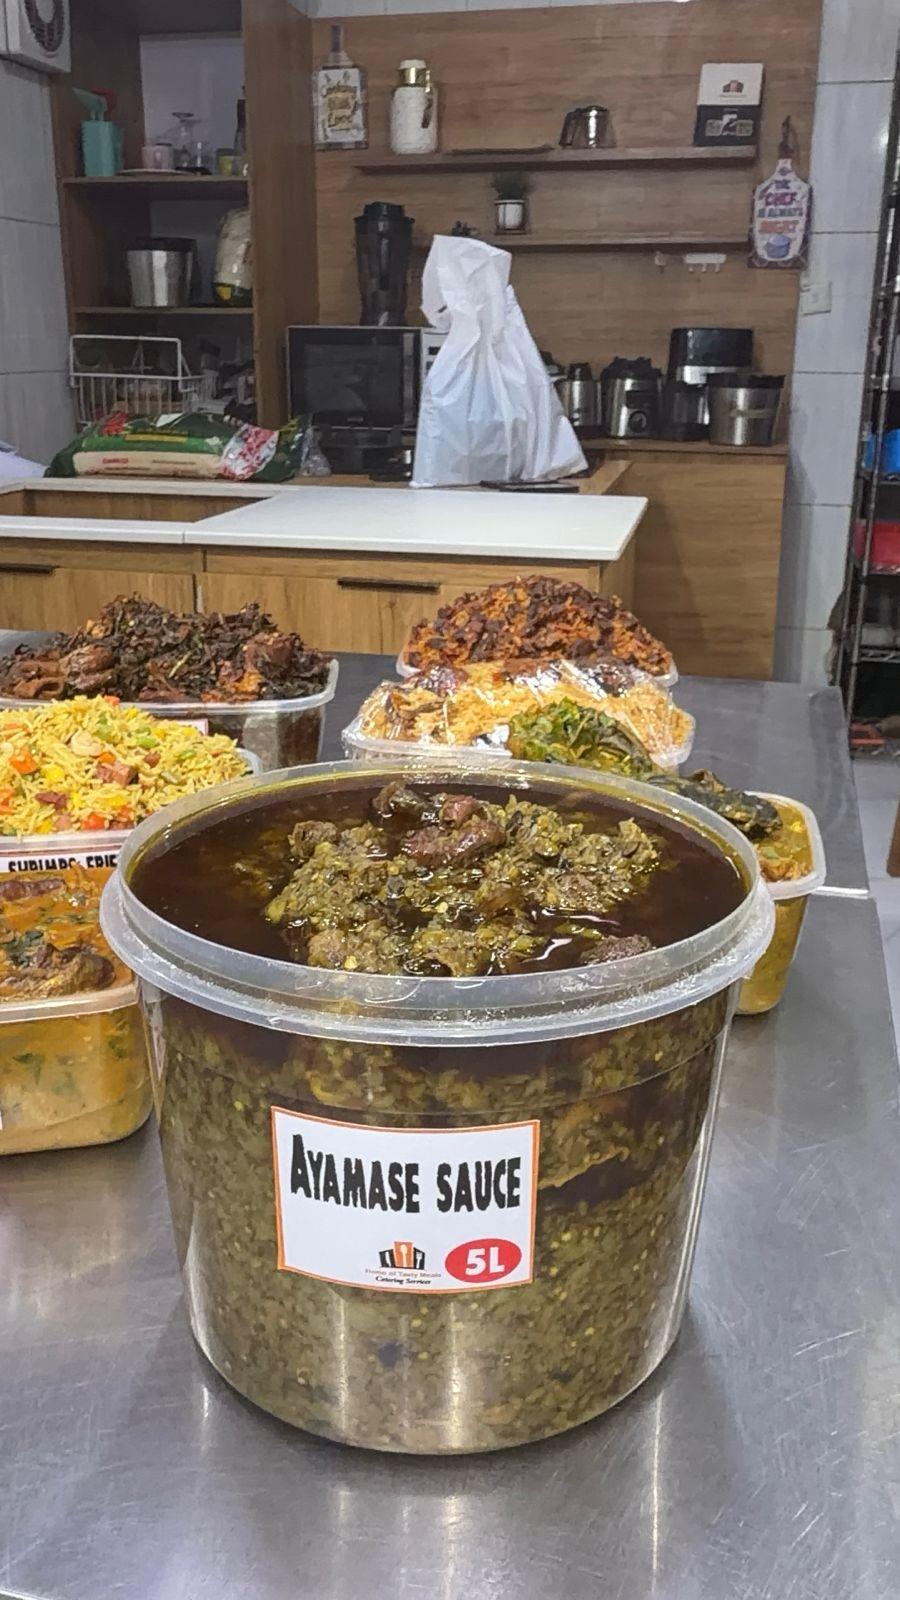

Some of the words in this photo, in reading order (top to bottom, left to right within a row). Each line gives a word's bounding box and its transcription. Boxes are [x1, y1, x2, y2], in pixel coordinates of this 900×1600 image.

[290, 1133, 420, 1213] AYAMASE
[436, 1157, 521, 1213] SAUCE
[465, 1246, 506, 1276] 5L
[375, 1275, 404, 1285] Catering
